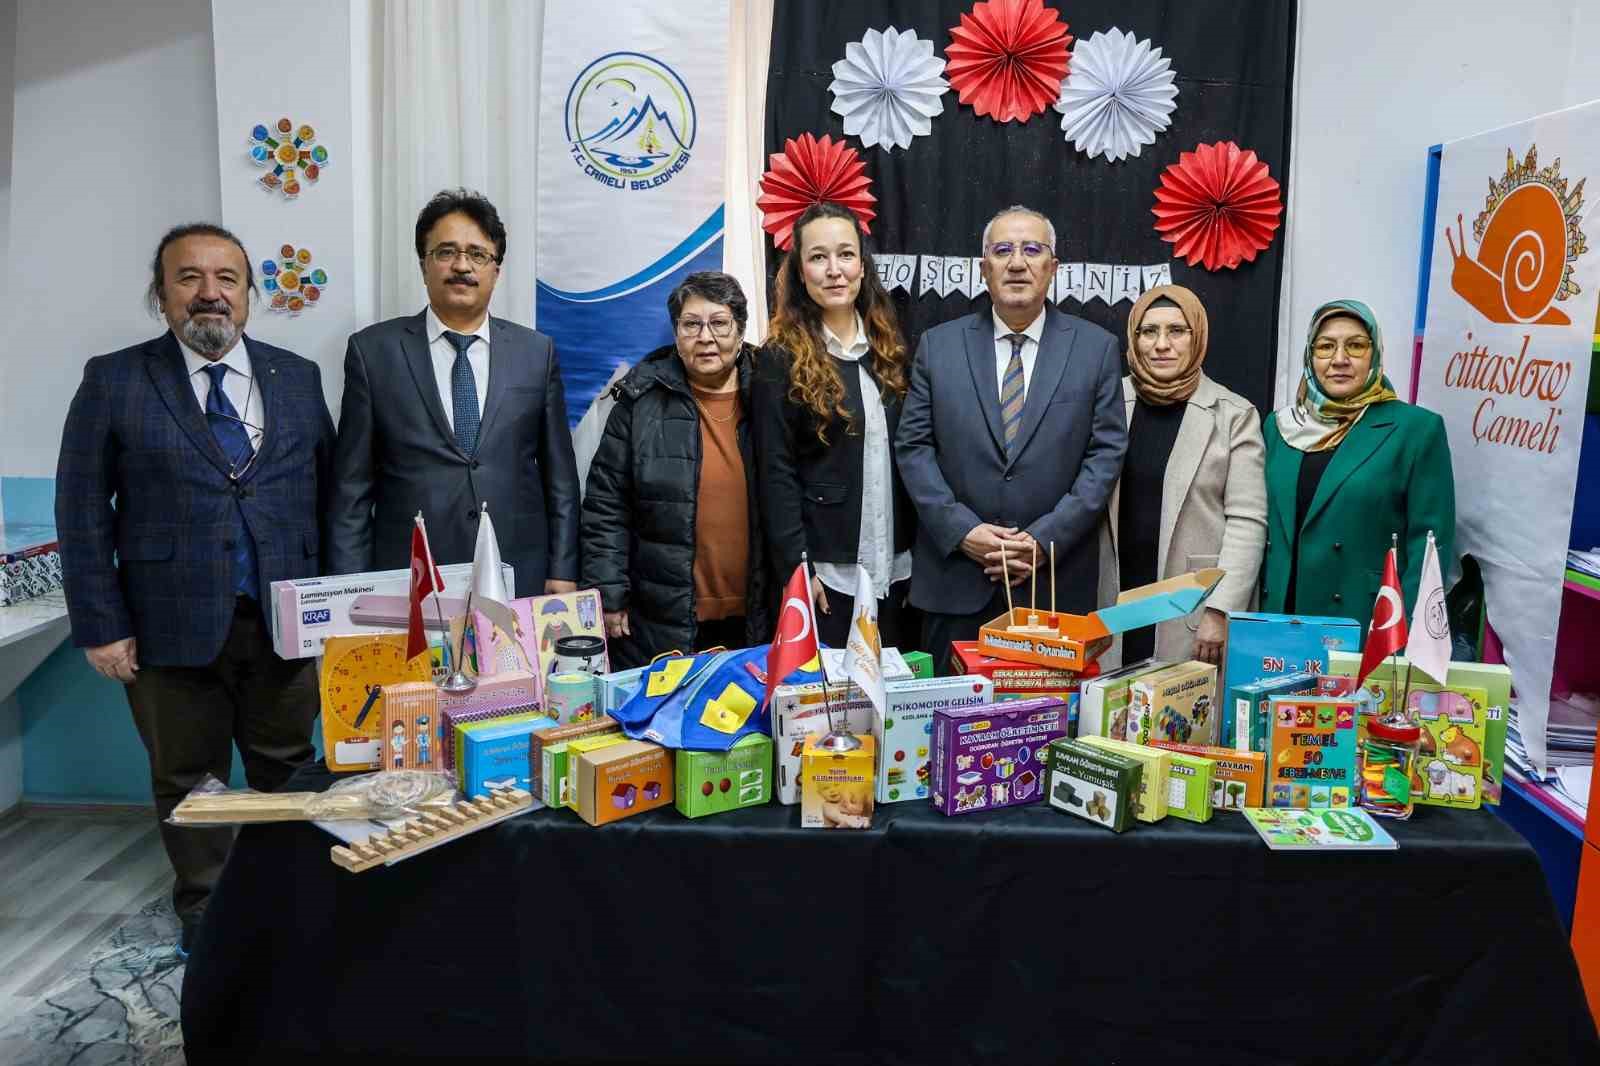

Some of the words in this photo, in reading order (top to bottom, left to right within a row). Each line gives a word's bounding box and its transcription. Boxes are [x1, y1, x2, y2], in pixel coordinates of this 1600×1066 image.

[1444, 331, 1572, 402] cittaslow
[1472, 397, 1563, 454] Çameli
[1263, 656, 1285, 673] 5N
[1304, 658, 1322, 674] 1K
[1290, 732, 1339, 747] TEMEL
[1303, 750, 1324, 765] 50
